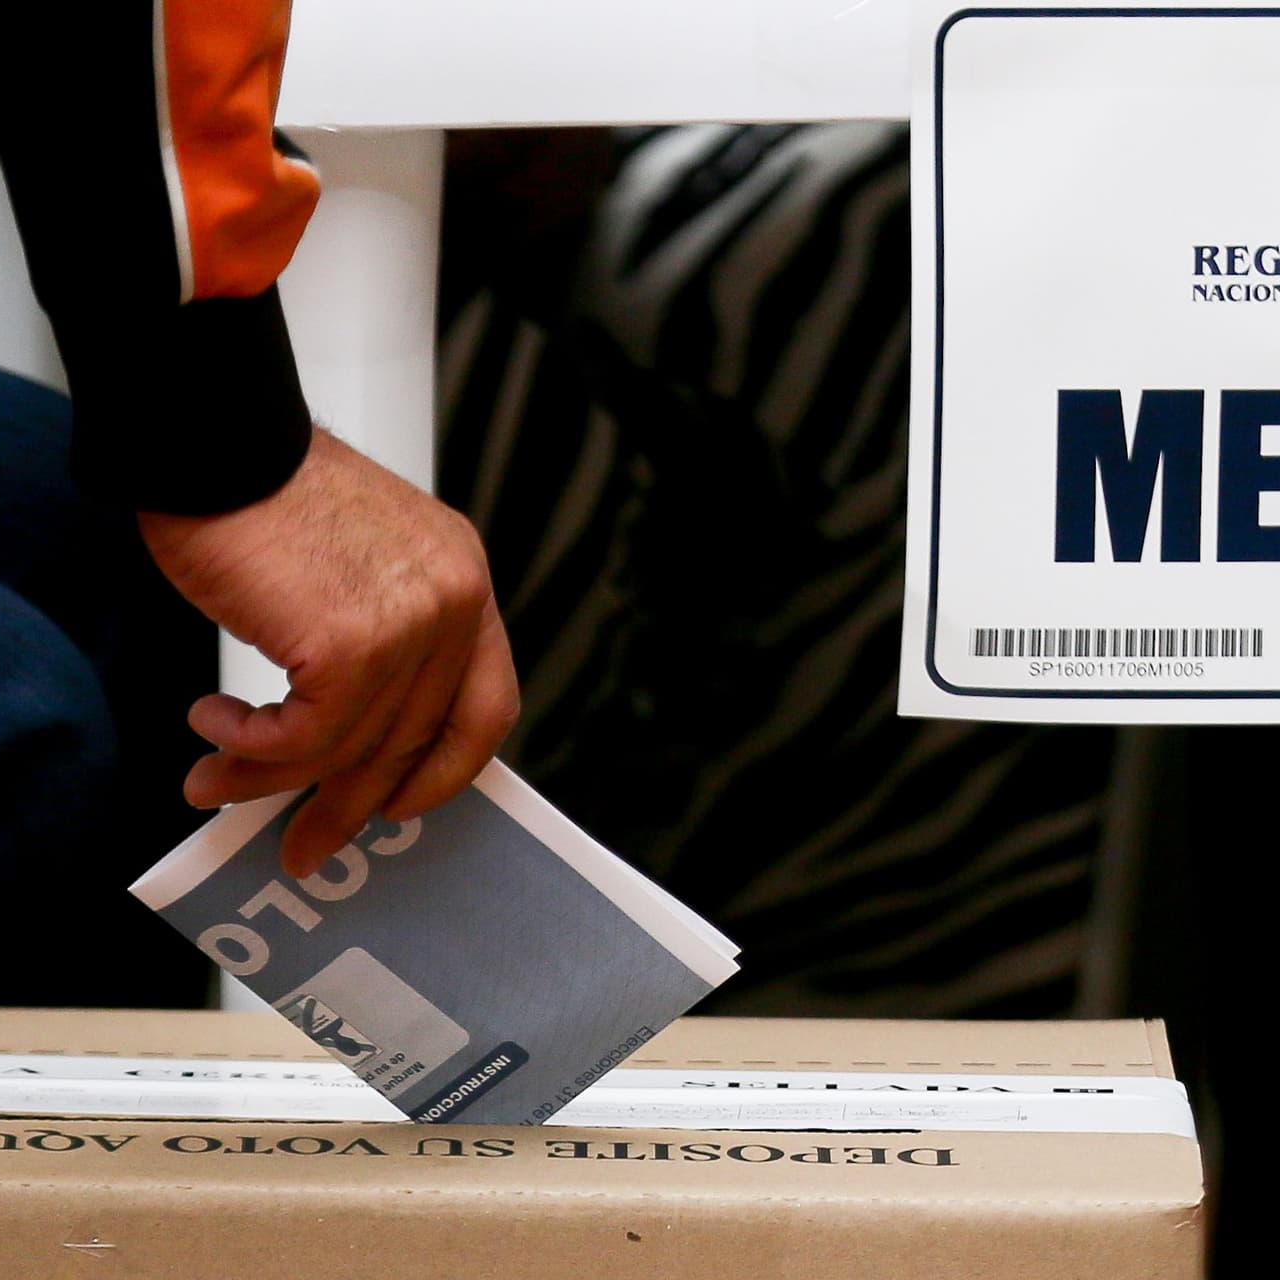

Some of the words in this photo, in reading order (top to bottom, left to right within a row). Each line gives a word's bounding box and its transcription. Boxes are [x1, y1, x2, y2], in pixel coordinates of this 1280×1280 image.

[390, 1052, 406, 1066] de
[371, 1063, 391, 1077] su
[383, 1061, 426, 1092] Marque
[162, 1135, 389, 1157] VOTO
[410, 1139, 515, 1158] SU
[546, 1140, 961, 1167] DEPOSITE
